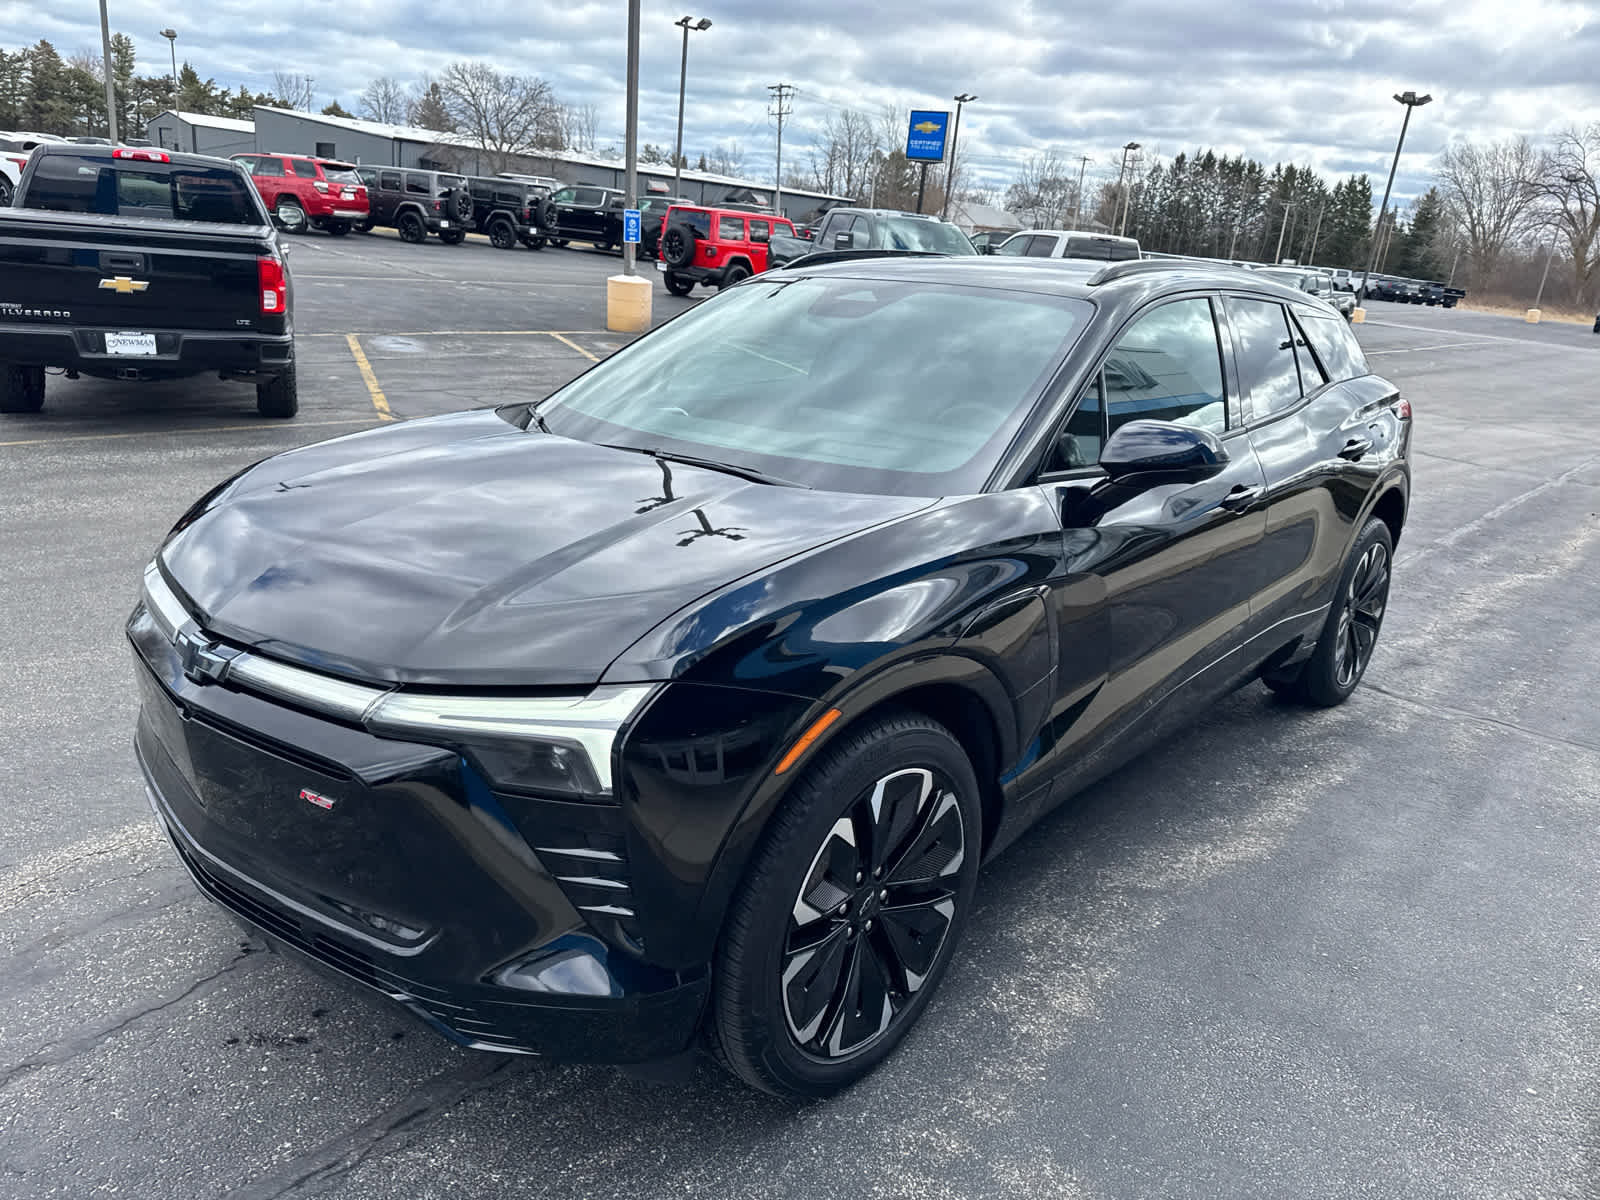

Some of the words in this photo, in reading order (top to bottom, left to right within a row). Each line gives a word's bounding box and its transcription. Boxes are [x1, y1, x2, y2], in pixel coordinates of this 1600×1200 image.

[1, 308, 72, 318] ILVERADO
[117, 338, 155, 346] NEWMAN
[299, 788, 336, 810] RS
